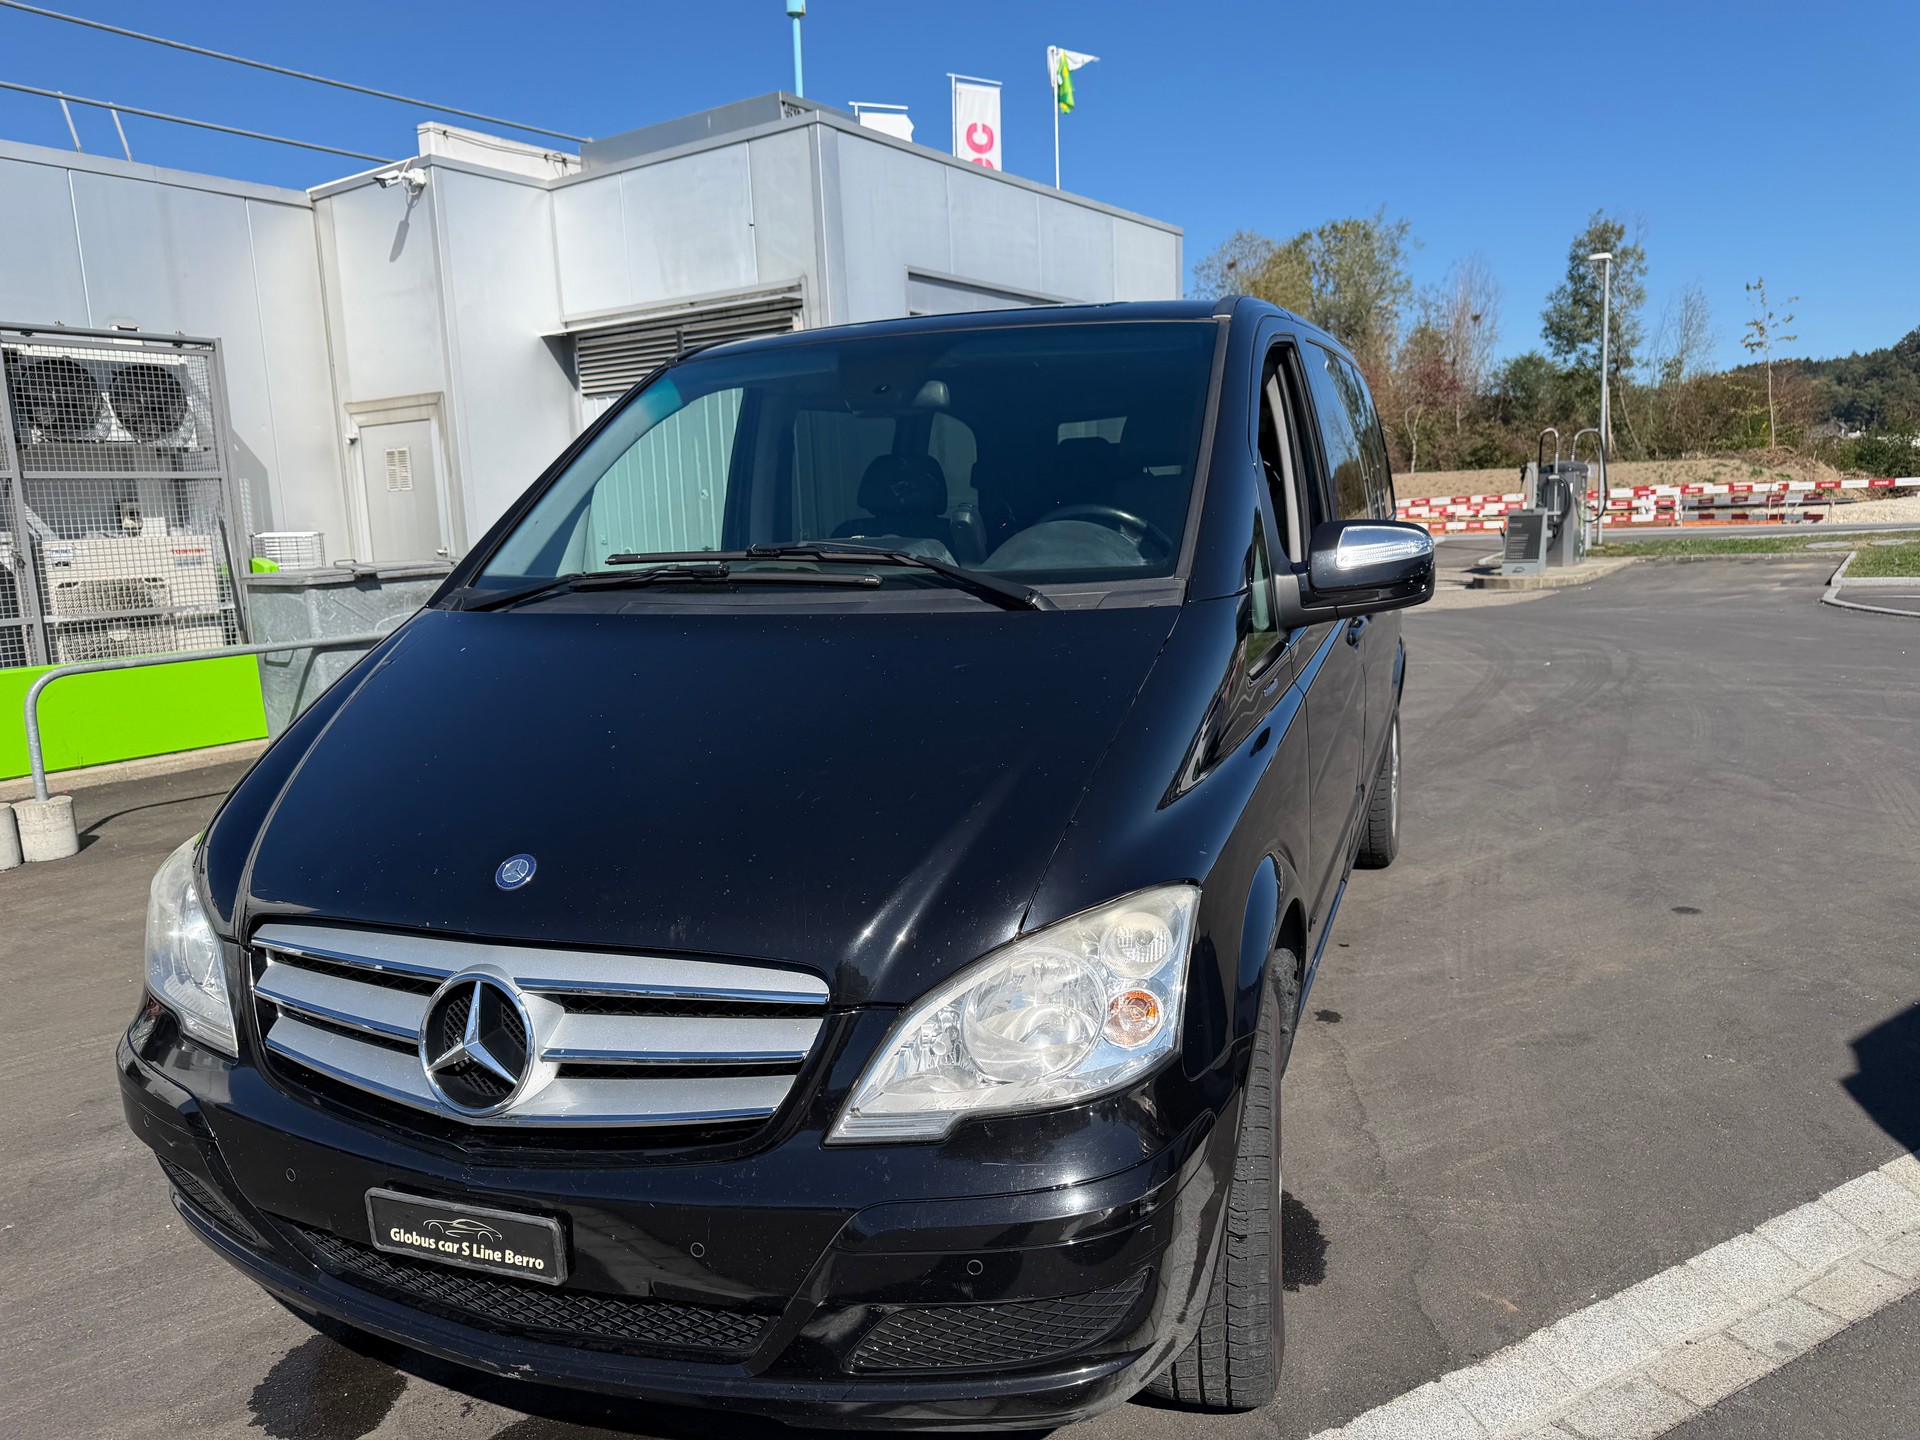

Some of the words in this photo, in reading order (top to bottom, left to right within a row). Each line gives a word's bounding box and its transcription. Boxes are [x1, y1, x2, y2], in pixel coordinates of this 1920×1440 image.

[390, 1228, 436, 1249] Globus
[438, 1240, 459, 1254] car
[461, 1241, 470, 1256] S
[472, 1243, 502, 1262] Line
[504, 1249, 545, 1270] Berro
